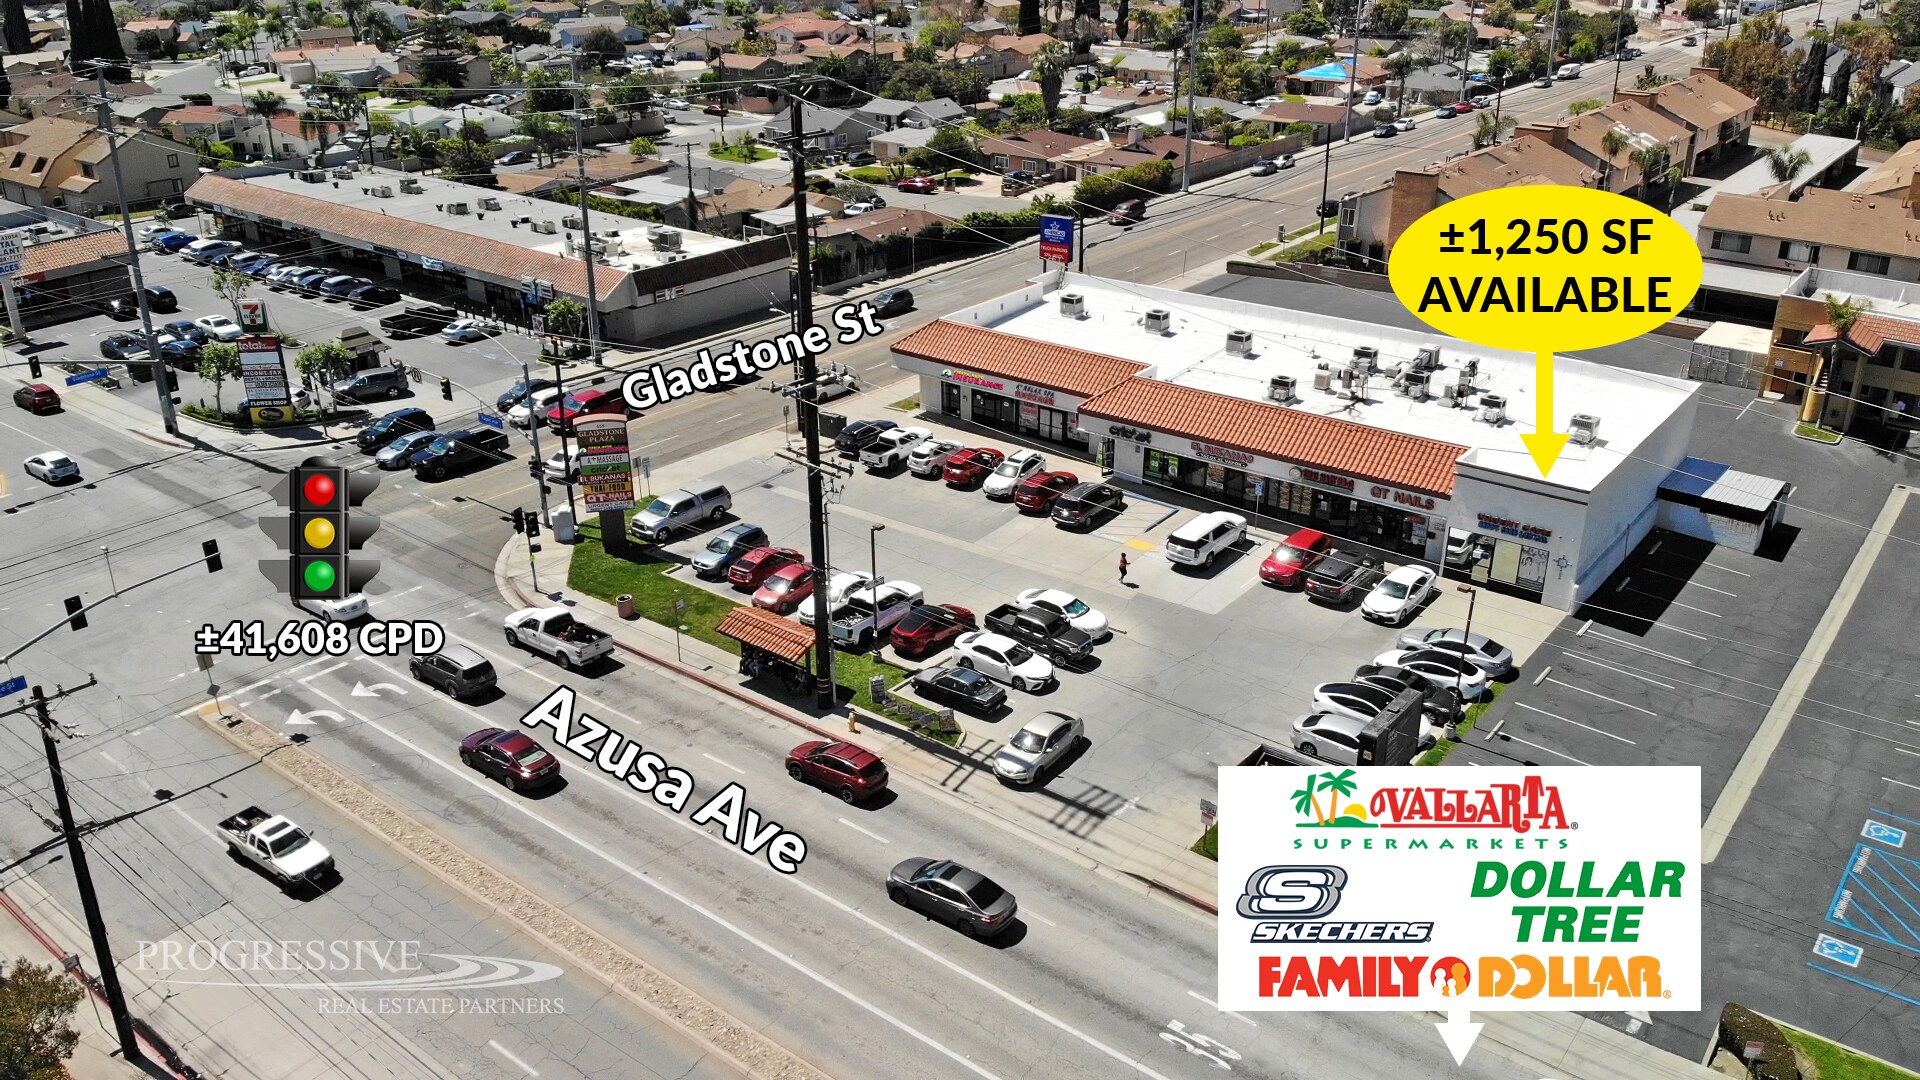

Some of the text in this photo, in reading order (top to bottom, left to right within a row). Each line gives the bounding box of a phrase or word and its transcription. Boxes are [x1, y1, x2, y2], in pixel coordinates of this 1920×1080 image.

[0, 247, 20, 256] ANT
[242, 304, 259, 325] 7
[238, 341, 262, 350] total
[953, 373, 1004, 390] INSURANCE
[1023, 385, 1042, 395] RELAX
[1043, 390, 1055, 398] SPA
[578, 429, 625, 438] GLADSTONE
[597, 454, 623, 463] MASSAGE
[1191, 442, 1254, 464] EL BUKANAS
[591, 465, 621, 474] cricket
[580, 473, 626, 483] EL BUKANAS
[587, 494, 605, 502] QT
[608, 491, 632, 499] NAILS
[1371, 486, 1435, 510] QT NAILS
[1477, 513, 1552, 537] URGENT CARE
